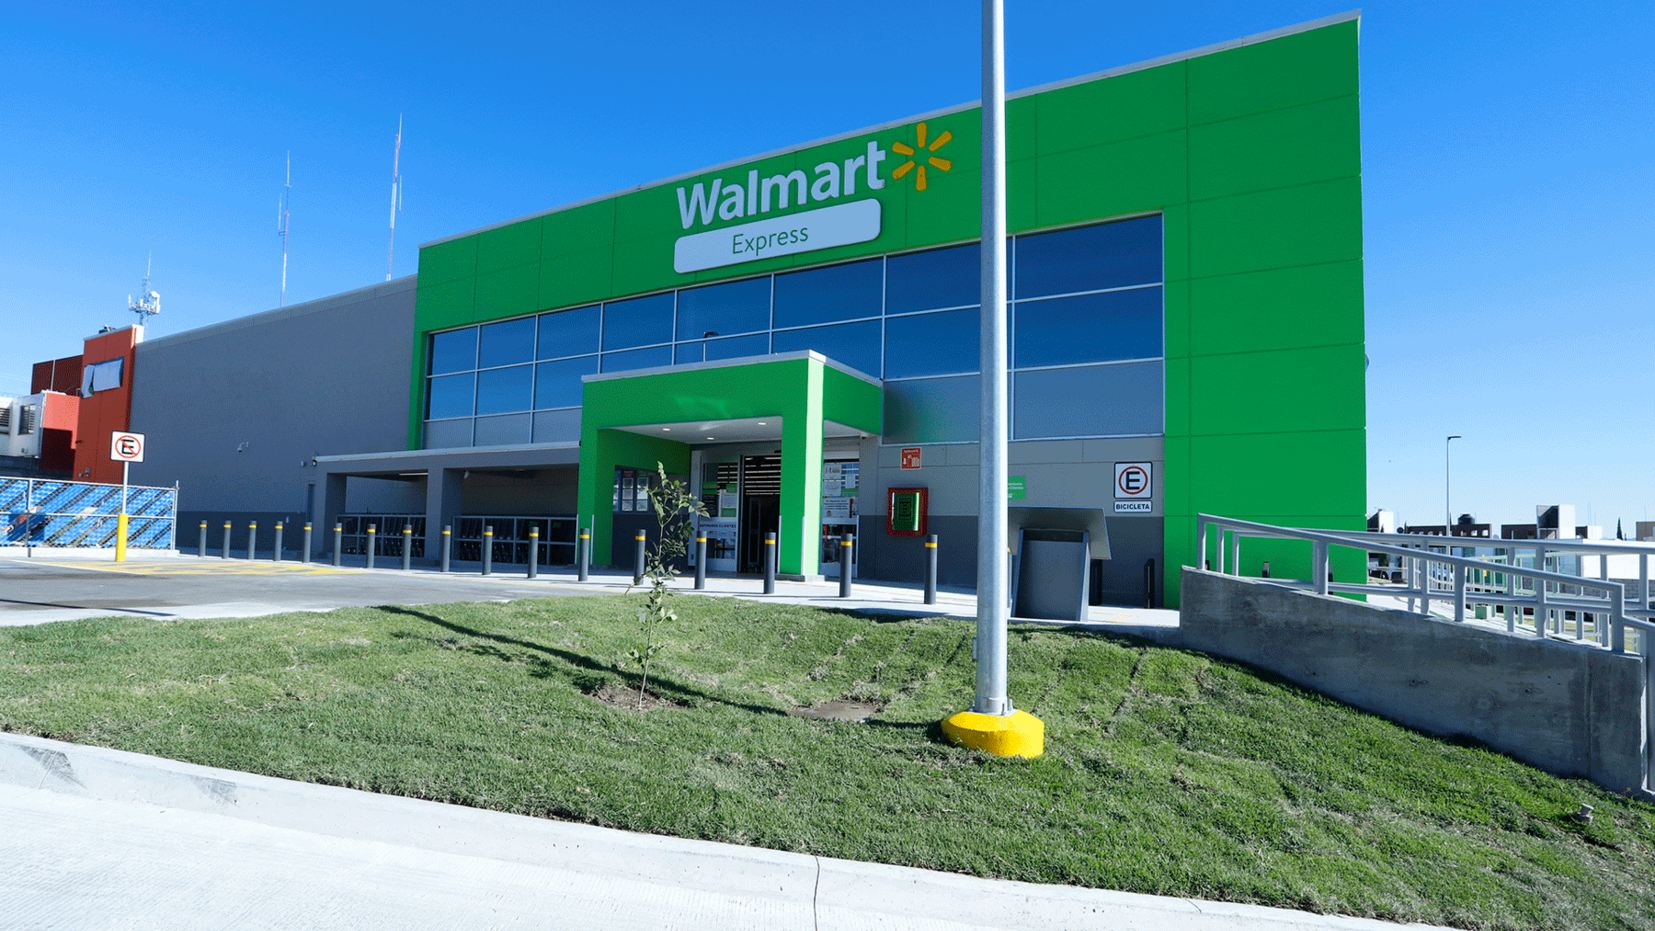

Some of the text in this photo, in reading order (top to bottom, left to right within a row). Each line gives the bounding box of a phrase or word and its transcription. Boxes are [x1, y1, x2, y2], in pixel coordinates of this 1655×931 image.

[677, 141, 886, 230] Walmart
[732, 227, 809, 256] Express
[122, 439, 134, 455] E
[1126, 471, 1140, 490] E
